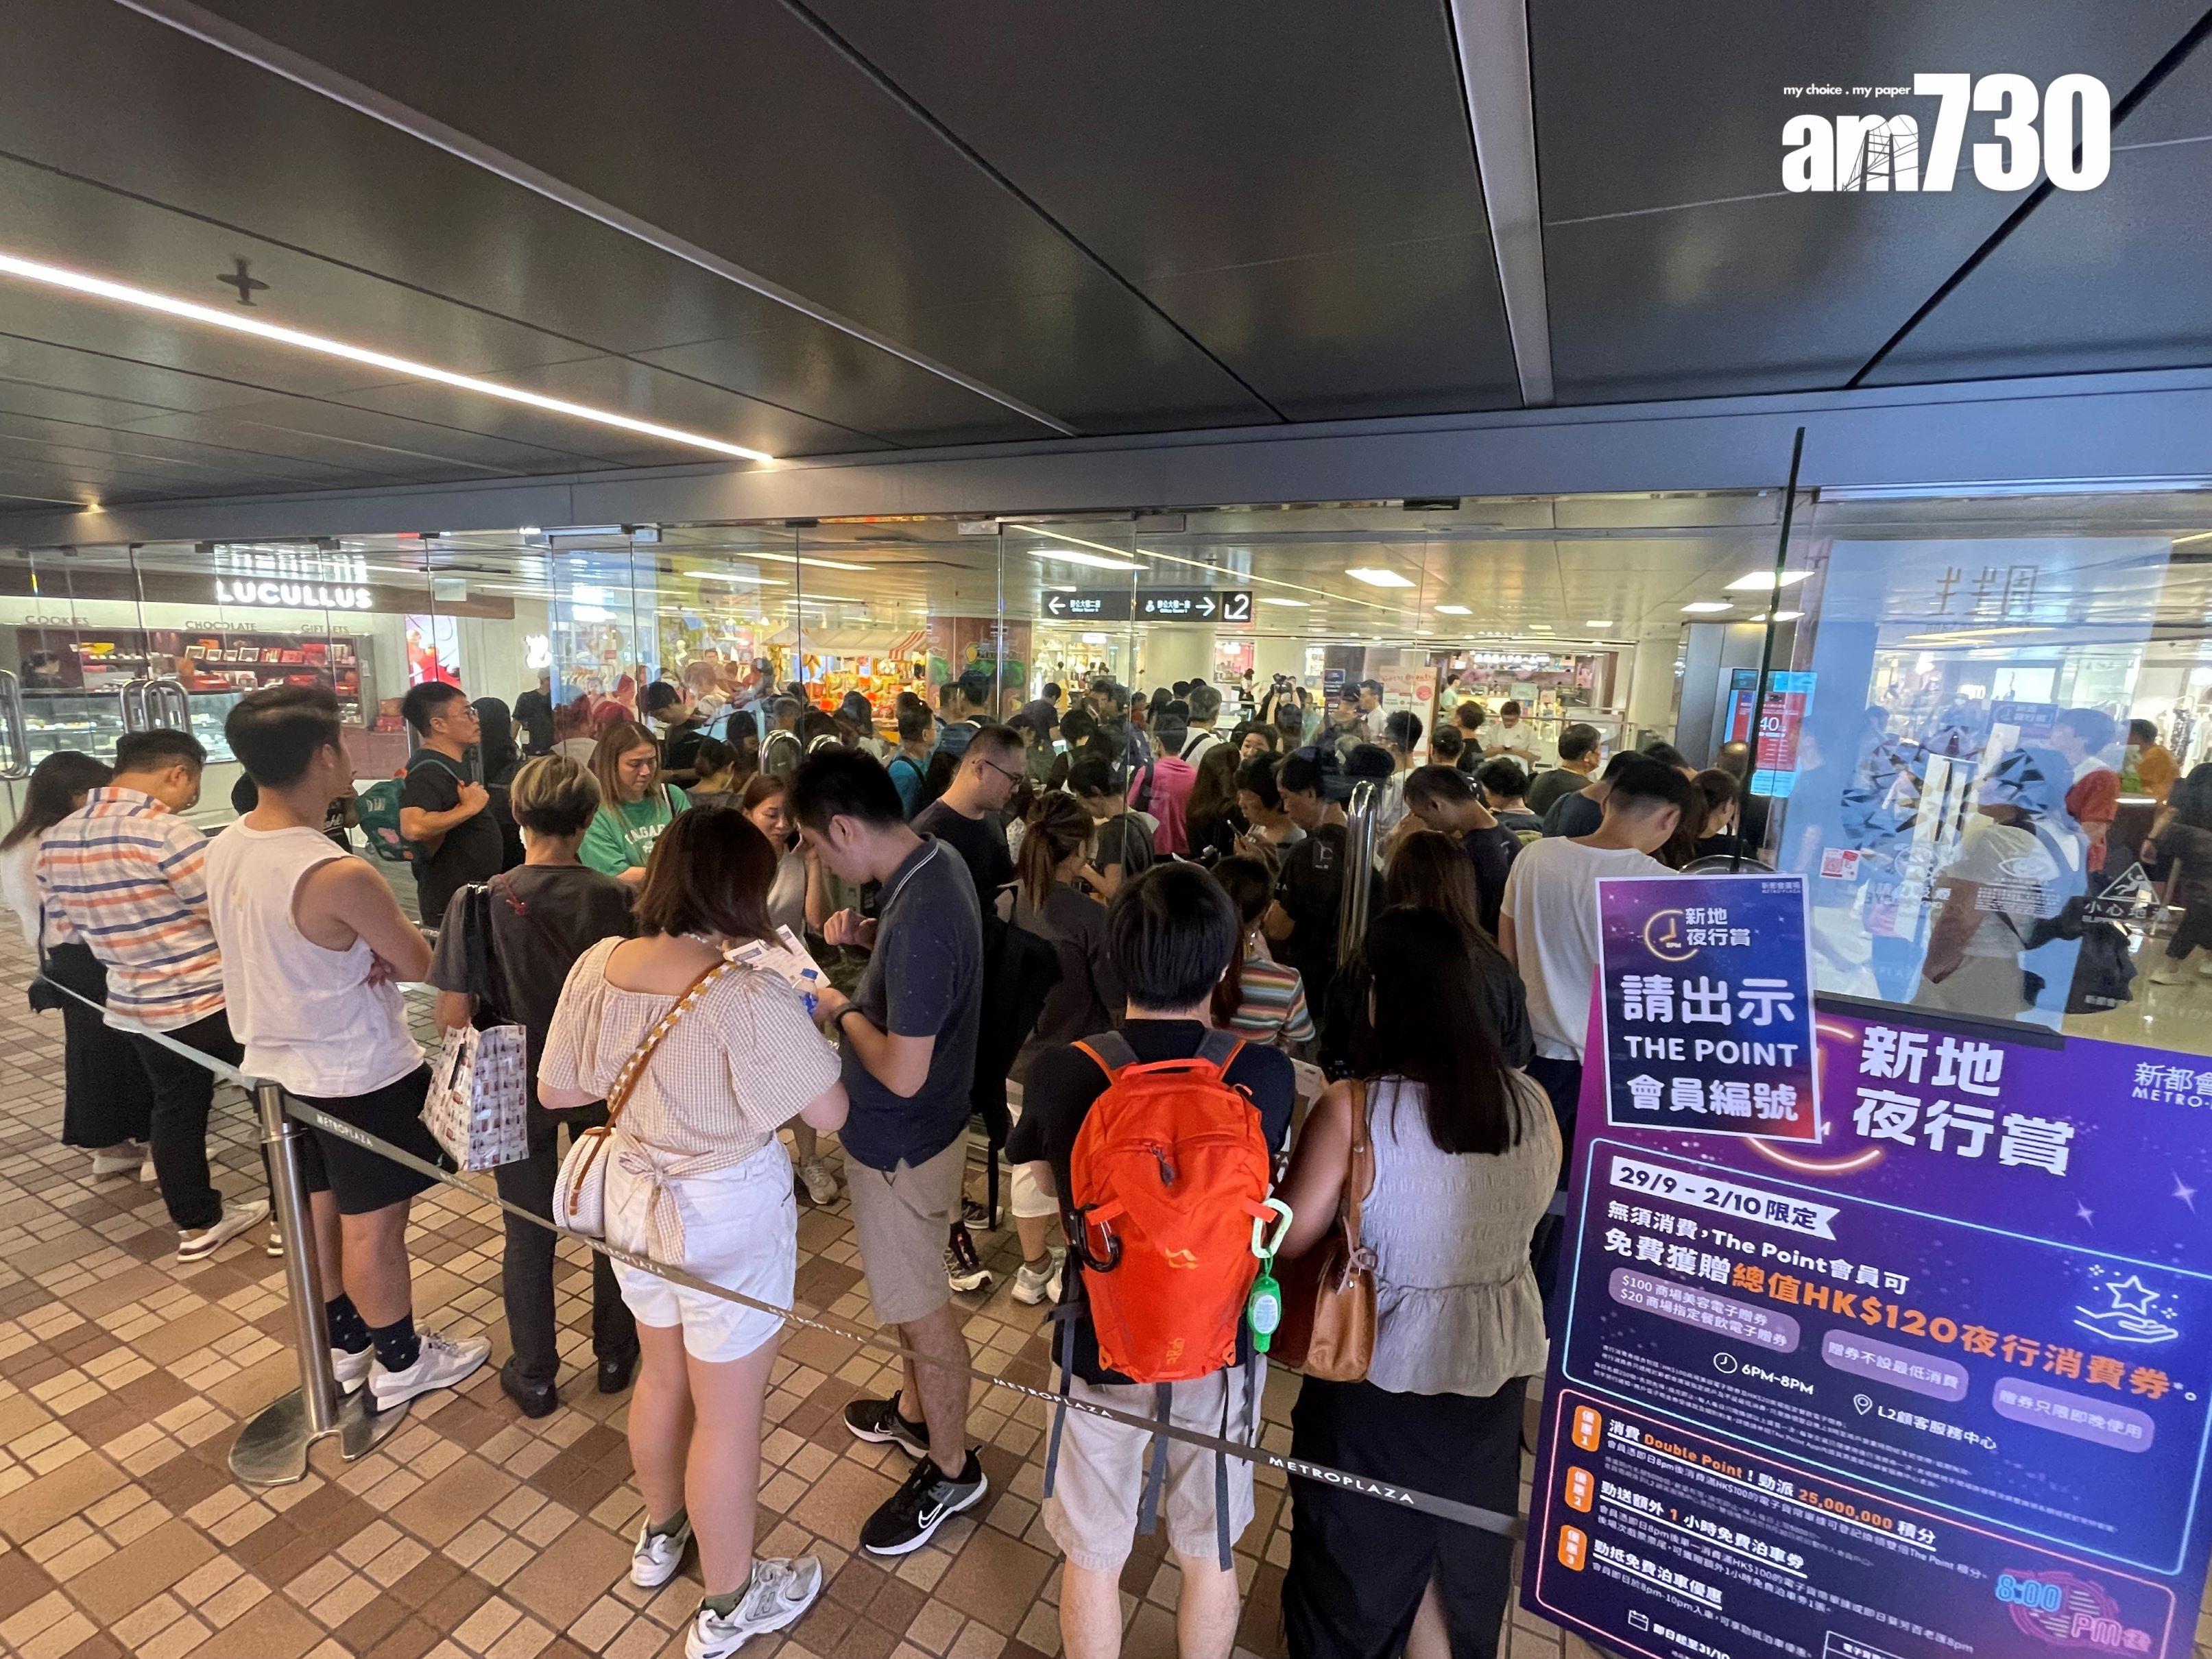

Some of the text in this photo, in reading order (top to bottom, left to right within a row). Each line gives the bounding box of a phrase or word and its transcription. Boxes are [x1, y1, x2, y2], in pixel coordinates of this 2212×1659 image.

[215, 579, 372, 609] LUCULLUS
[1225, 594, 1249, 620] L2
[185, 620, 256, 631] CHOCOLATE
[301, 625, 324, 633] GIFT
[1685, 908, 1728, 925] 新地
[1686, 928, 1751, 946] 夜行賞
[1621, 974, 1795, 1026] 請出示
[1624, 1036, 1799, 1067] THE POINT
[1859, 1026, 2004, 1097] 新地
[1626, 1074, 1799, 1122] 會員編號
[1853, 1087, 2076, 1176] 夜行賞
[1618, 1166, 1678, 1194] 29/9
[1703, 1187, 1762, 1216] 2/10
[1765, 1199, 1817, 1231] 限定
[1620, 1288, 1644, 1303] $20
[1622, 1274, 1768, 1326] $100 商場美容電子贈券
[1742, 1364, 1814, 1396] 6PM-8PM
[1829, 1341, 1958, 1390] 贈券不設最低消費
[1269, 1456, 1415, 1505] METROPLAZA
[1609, 1419, 1640, 1442] 消費
[1644, 1433, 1697, 1462] Double
[1702, 1454, 1742, 1479] Point
[1798, 1488, 1893, 1529] 25,000,000
[1897, 1521, 1936, 1545] 積分
[1670, 1507, 1678, 1521] 1
[1995, 1574, 2063, 1612] 8:00
